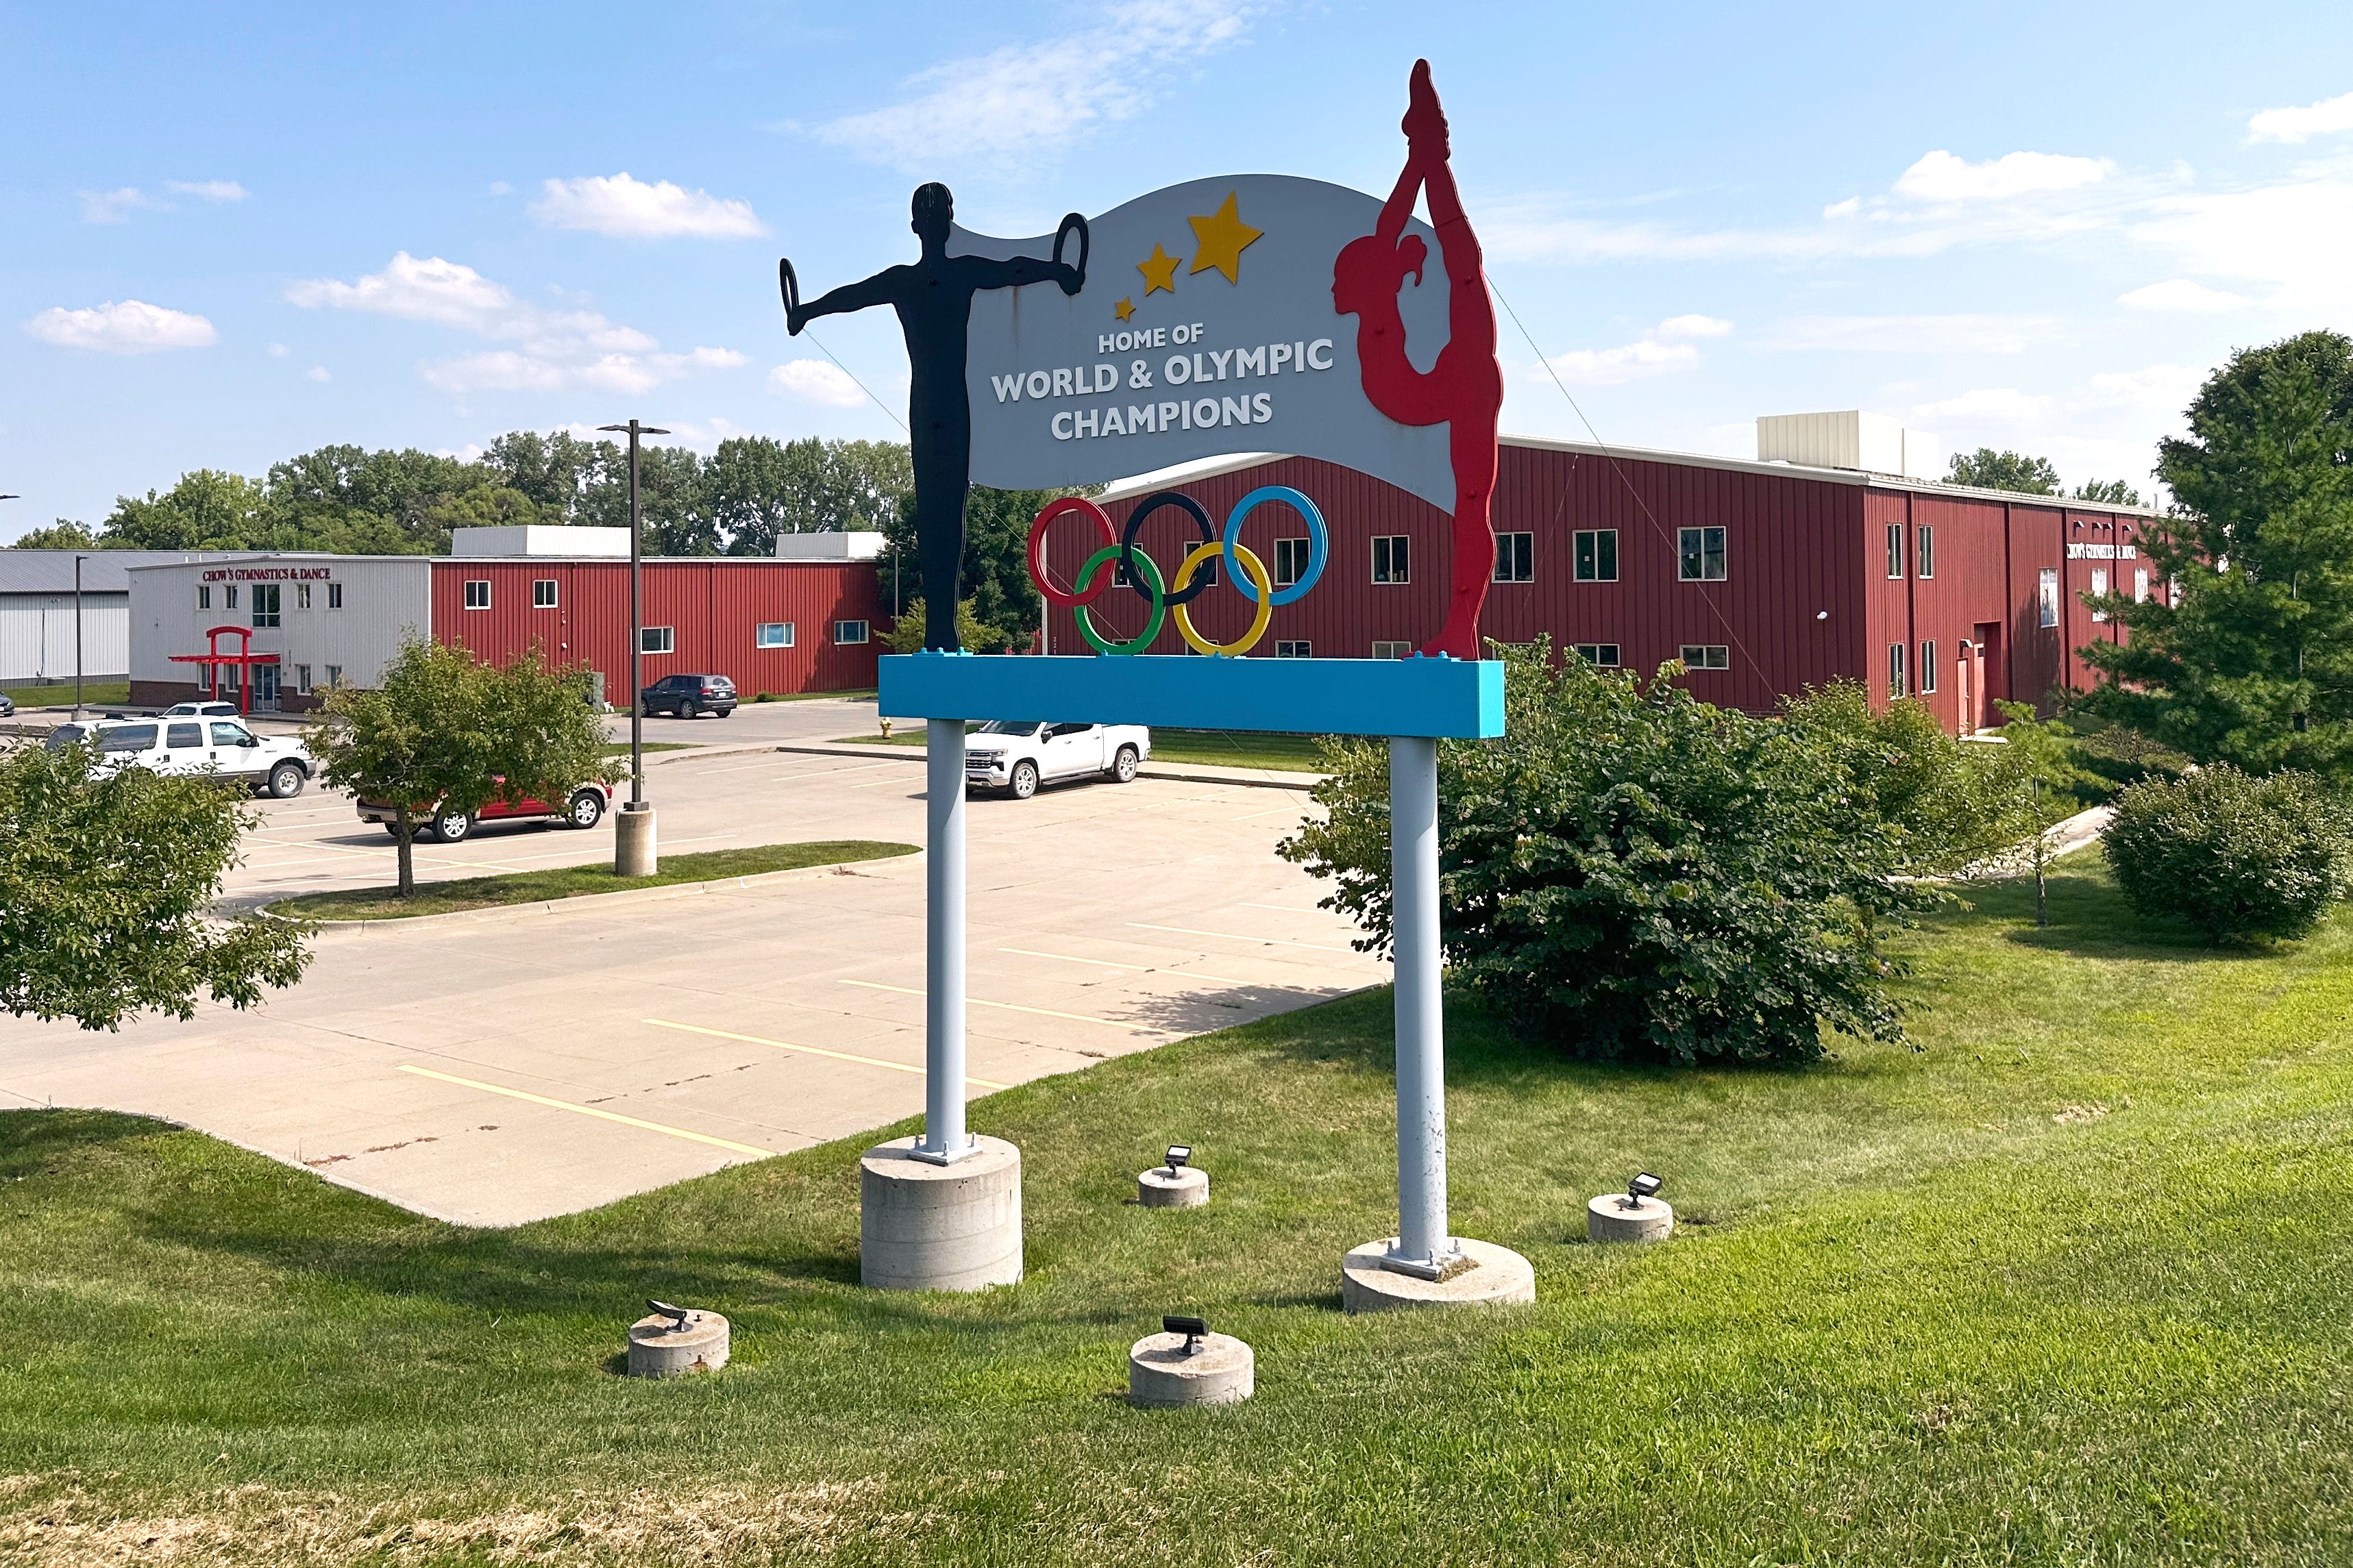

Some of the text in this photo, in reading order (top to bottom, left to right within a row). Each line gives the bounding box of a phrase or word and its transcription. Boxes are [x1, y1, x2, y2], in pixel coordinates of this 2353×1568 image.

[1098, 323, 1204, 353] HOME OF
[991, 338, 1333, 403] WORLD & OLYMPIC
[1051, 393, 1272, 440] CHAMPIONS
[203, 567, 330, 582] CHOW'S GYMNASTICS & DANCE
